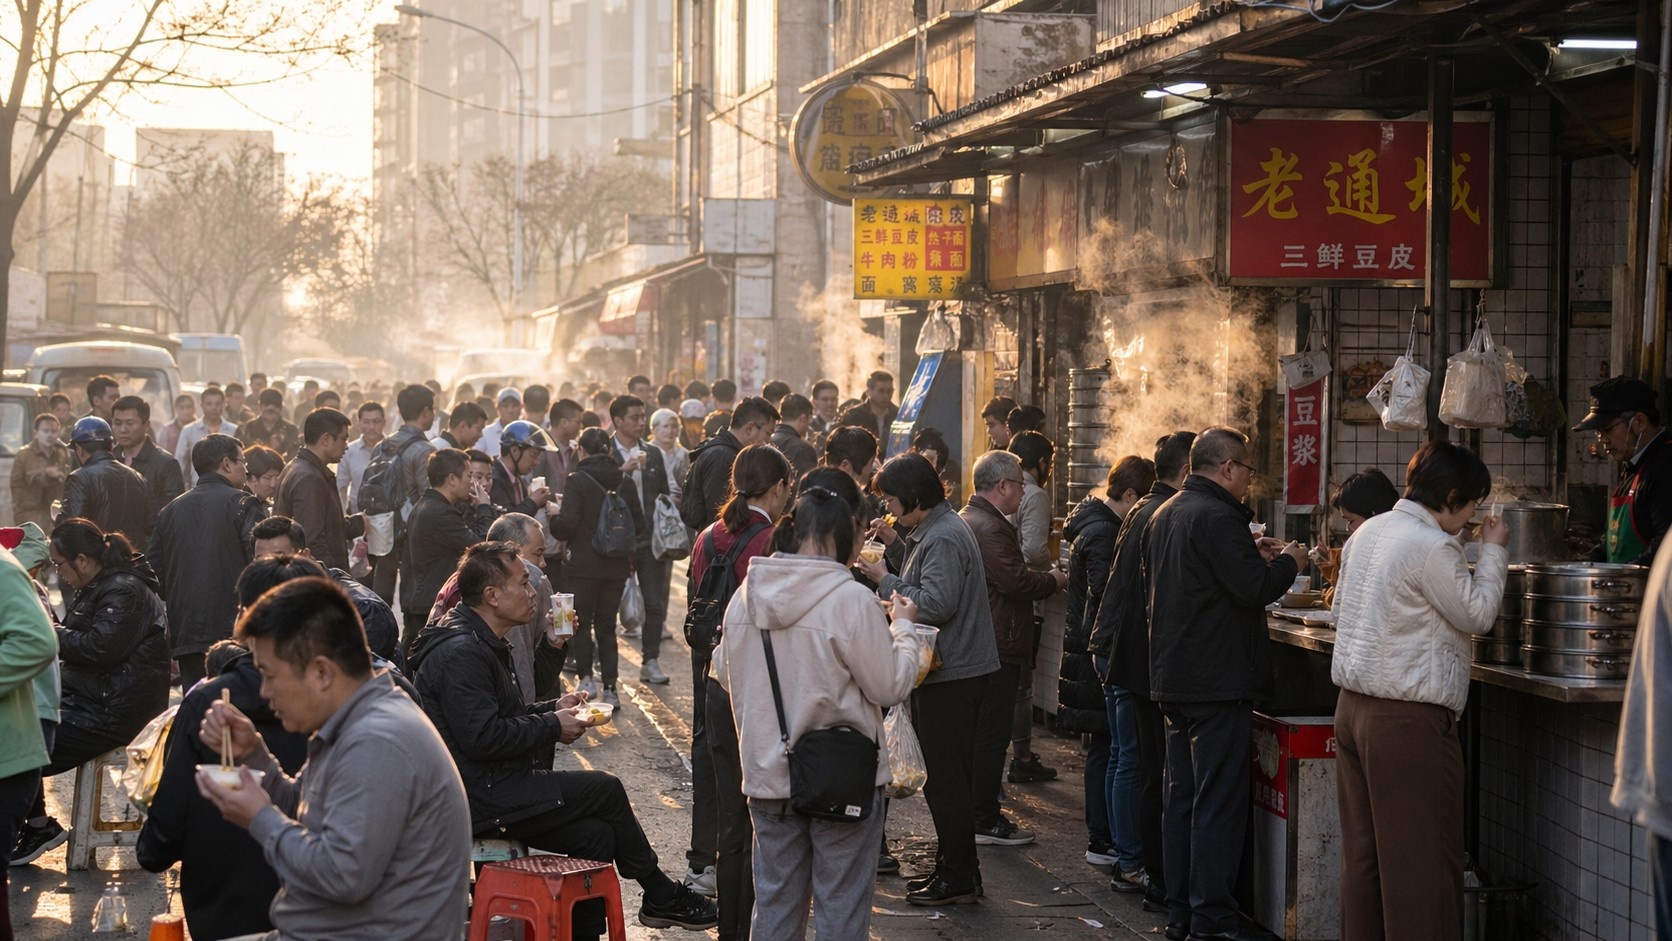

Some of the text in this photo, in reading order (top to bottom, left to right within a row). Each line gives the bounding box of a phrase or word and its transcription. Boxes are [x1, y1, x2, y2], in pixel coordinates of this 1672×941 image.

[1242, 147, 1481, 225] 老通城
[860, 251, 919, 269] 牛肉粉
[1280, 243, 1416, 270] 三鲜豆皮
[1292, 395, 1318, 466] 豆浆
